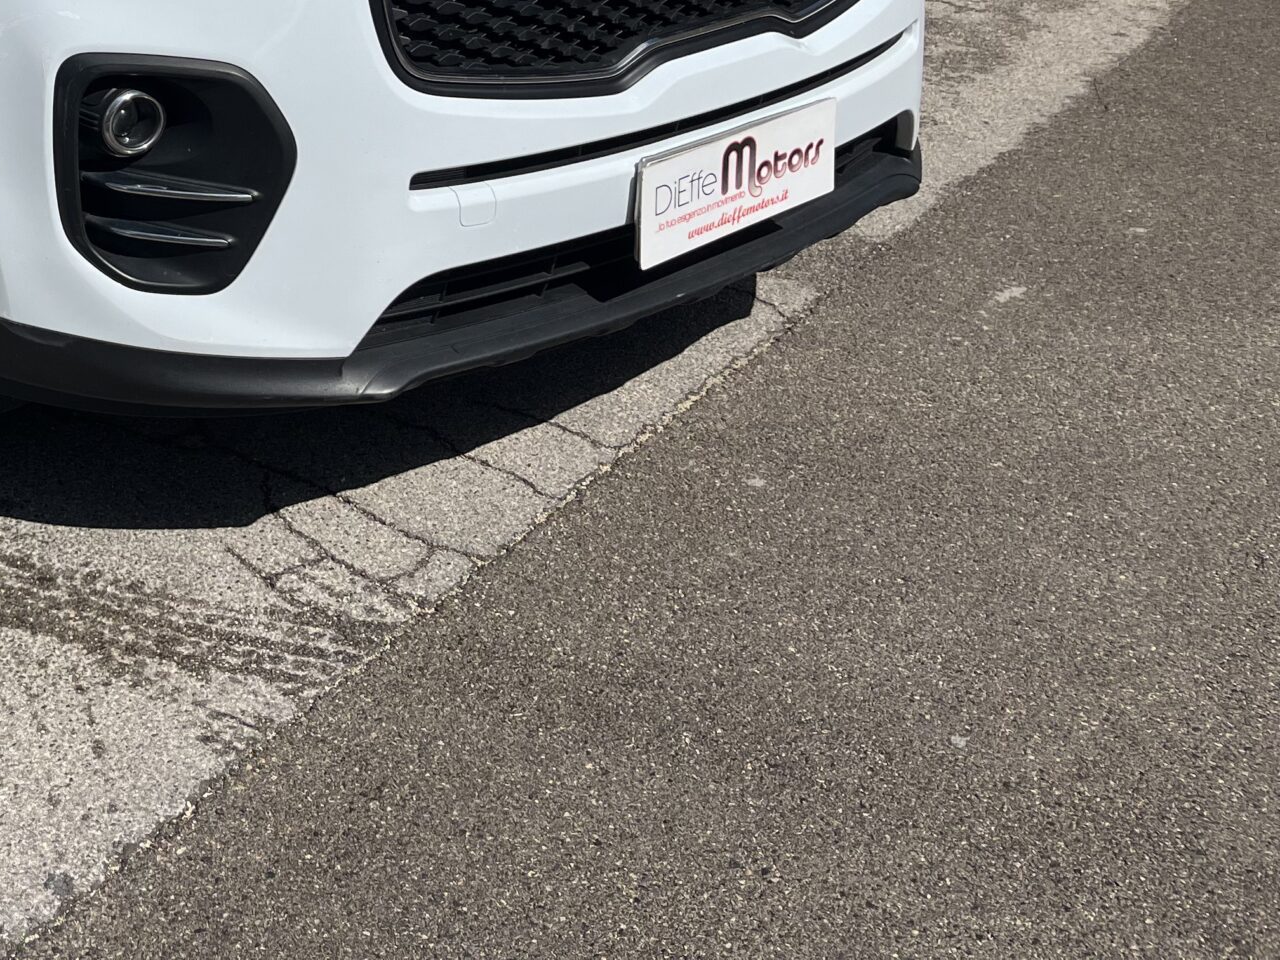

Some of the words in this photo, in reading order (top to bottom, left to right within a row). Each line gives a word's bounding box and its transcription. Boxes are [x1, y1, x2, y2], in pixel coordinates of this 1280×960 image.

[654, 169, 718, 216] DiEffe
[720, 136, 825, 198] Motors
[688, 189, 789, 240] www.dieffemotors.it
